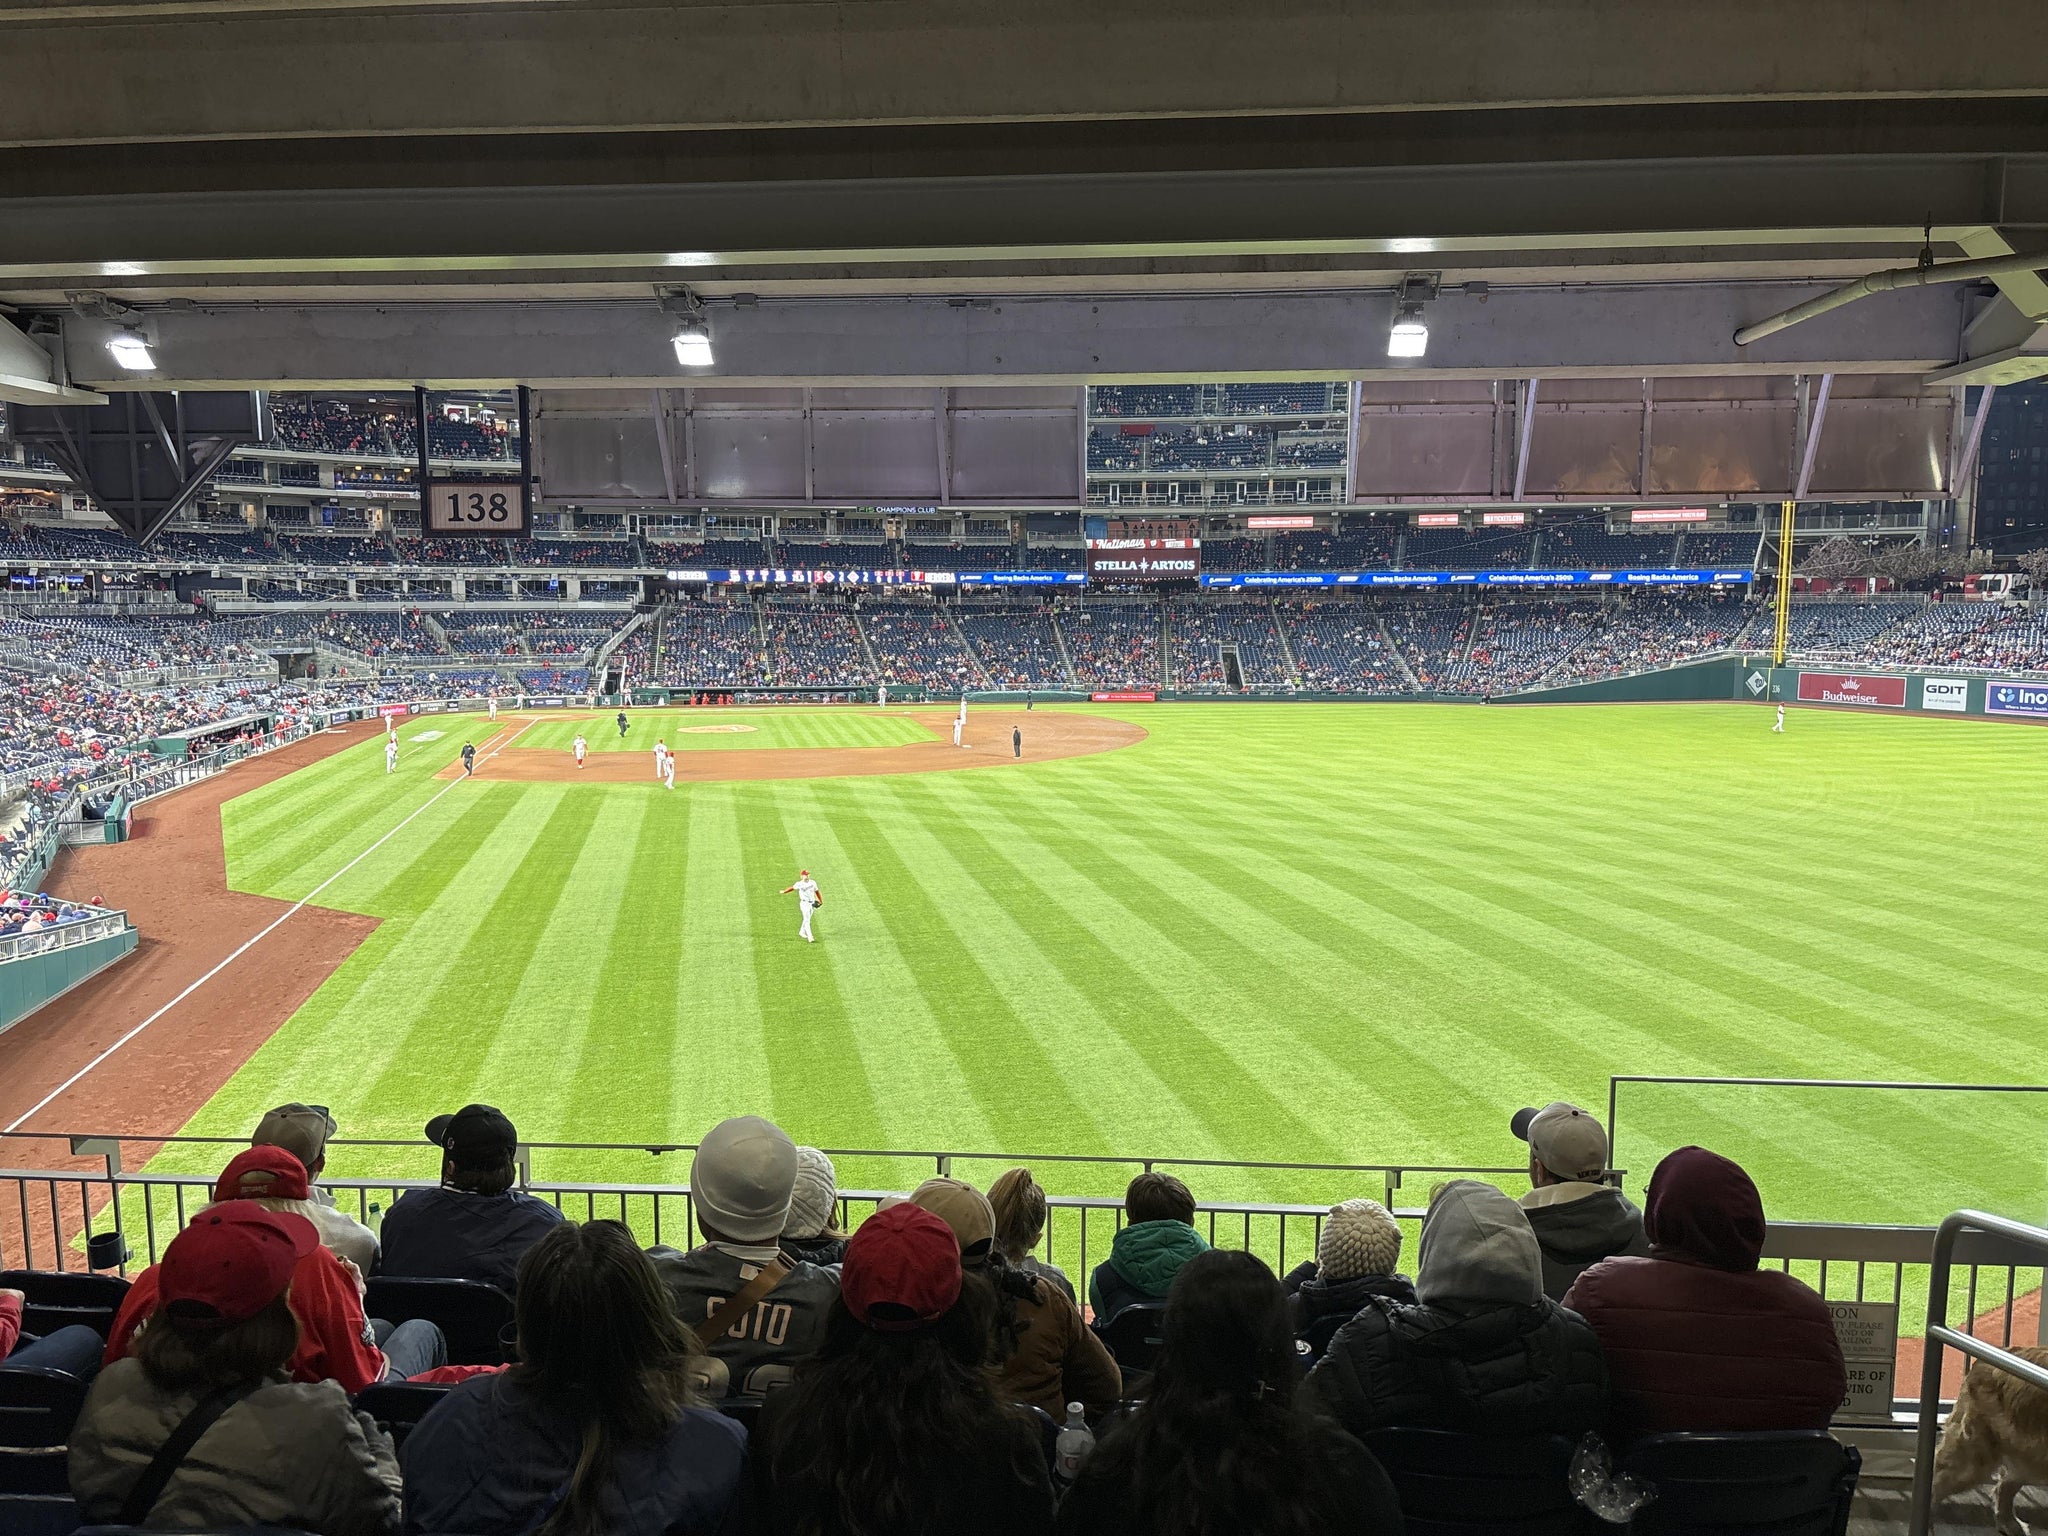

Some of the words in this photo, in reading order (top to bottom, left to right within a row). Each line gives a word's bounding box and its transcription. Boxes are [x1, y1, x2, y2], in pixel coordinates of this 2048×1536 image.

[448, 493, 508, 522] 138
[1096, 538, 1146, 549] Nationals
[1094, 561, 1137, 570] STELLA
[1150, 560, 1195, 570] ARTOIS
[114, 574, 138, 582] PNC
[1772, 685, 1780, 694] 336
[1926, 685, 1965, 695] GDIT
[2020, 689, 2048, 705] Ino
[1848, 1322, 1884, 1330] PLEASE
[1869, 1371, 1886, 1380] OF
